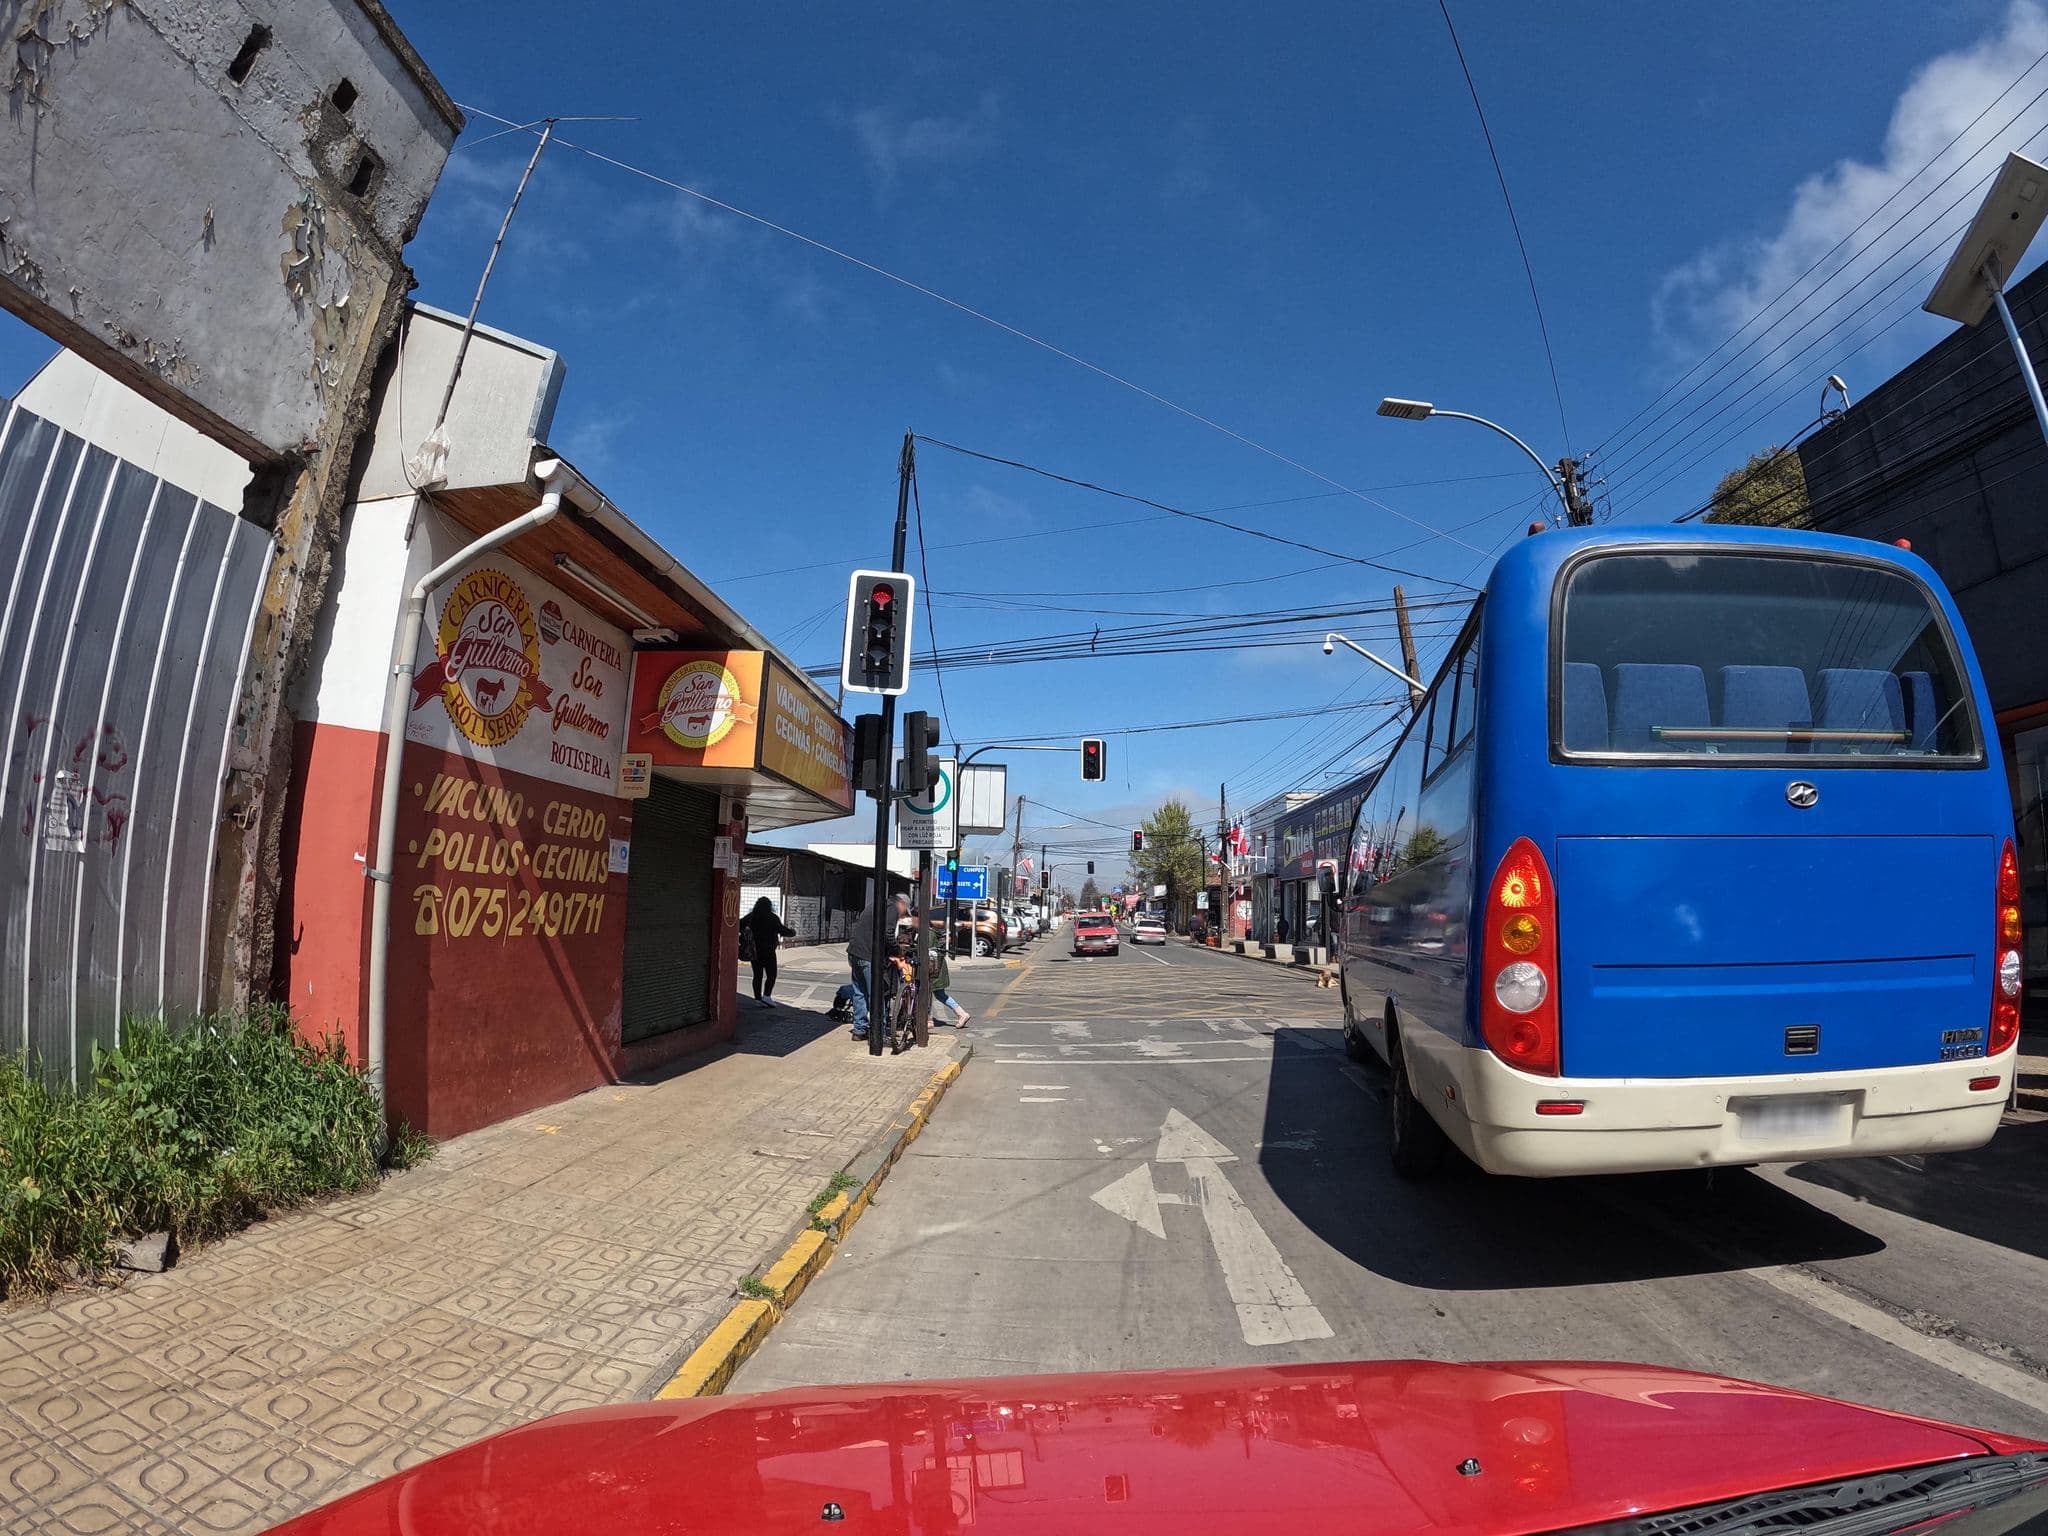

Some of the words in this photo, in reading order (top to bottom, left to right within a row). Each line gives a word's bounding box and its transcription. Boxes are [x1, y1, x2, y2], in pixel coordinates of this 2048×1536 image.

[449, 575, 535, 650] CARNICERIA
[478, 604, 514, 638] San
[444, 625, 530, 683] Guillermo
[562, 620, 623, 671] CARNICERIA
[572, 656, 604, 698] San
[685, 674, 714, 693] San
[451, 694, 527, 741] ROTISERIA
[552, 693, 611, 738] Guillermo
[662, 690, 732, 723] Guillermo
[776, 682, 810, 726] VACUNO
[775, 714, 811, 754] CECINAS
[550, 741, 611, 779] ROTISERIA
[423, 773, 524, 827] VACUNO
[543, 801, 607, 842] CERDO
[417, 828, 524, 877] POLLOS
[532, 844, 609, 884] CECINAS
